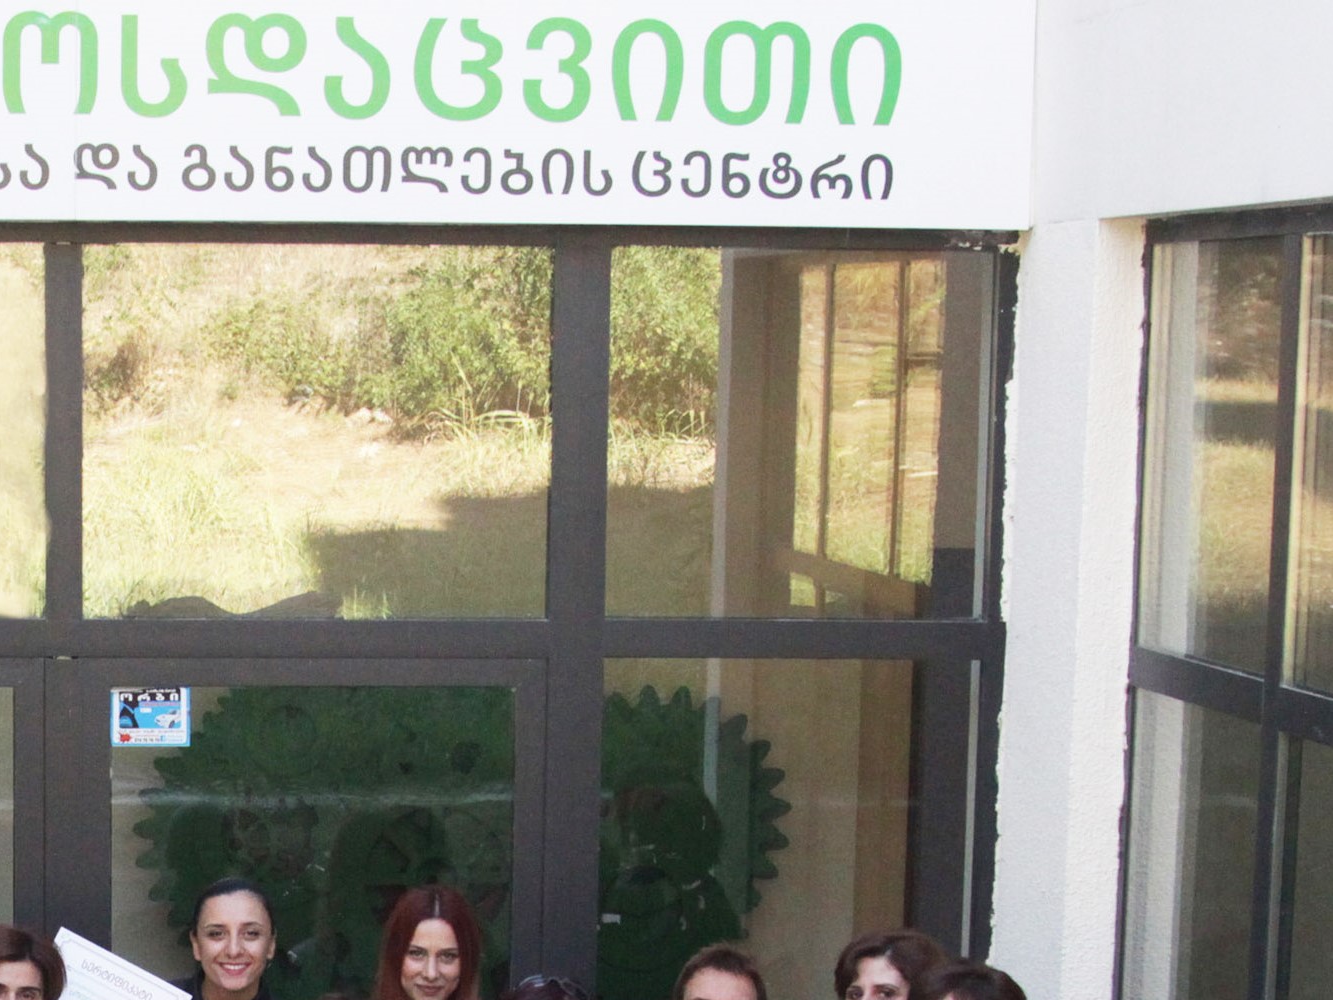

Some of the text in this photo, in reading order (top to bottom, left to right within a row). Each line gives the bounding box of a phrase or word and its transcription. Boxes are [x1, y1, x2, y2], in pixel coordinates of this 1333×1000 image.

[72, 143, 158, 191] და
[181, 144, 613, 196] განათლების
[631, 150, 895, 200] ცენტრი
